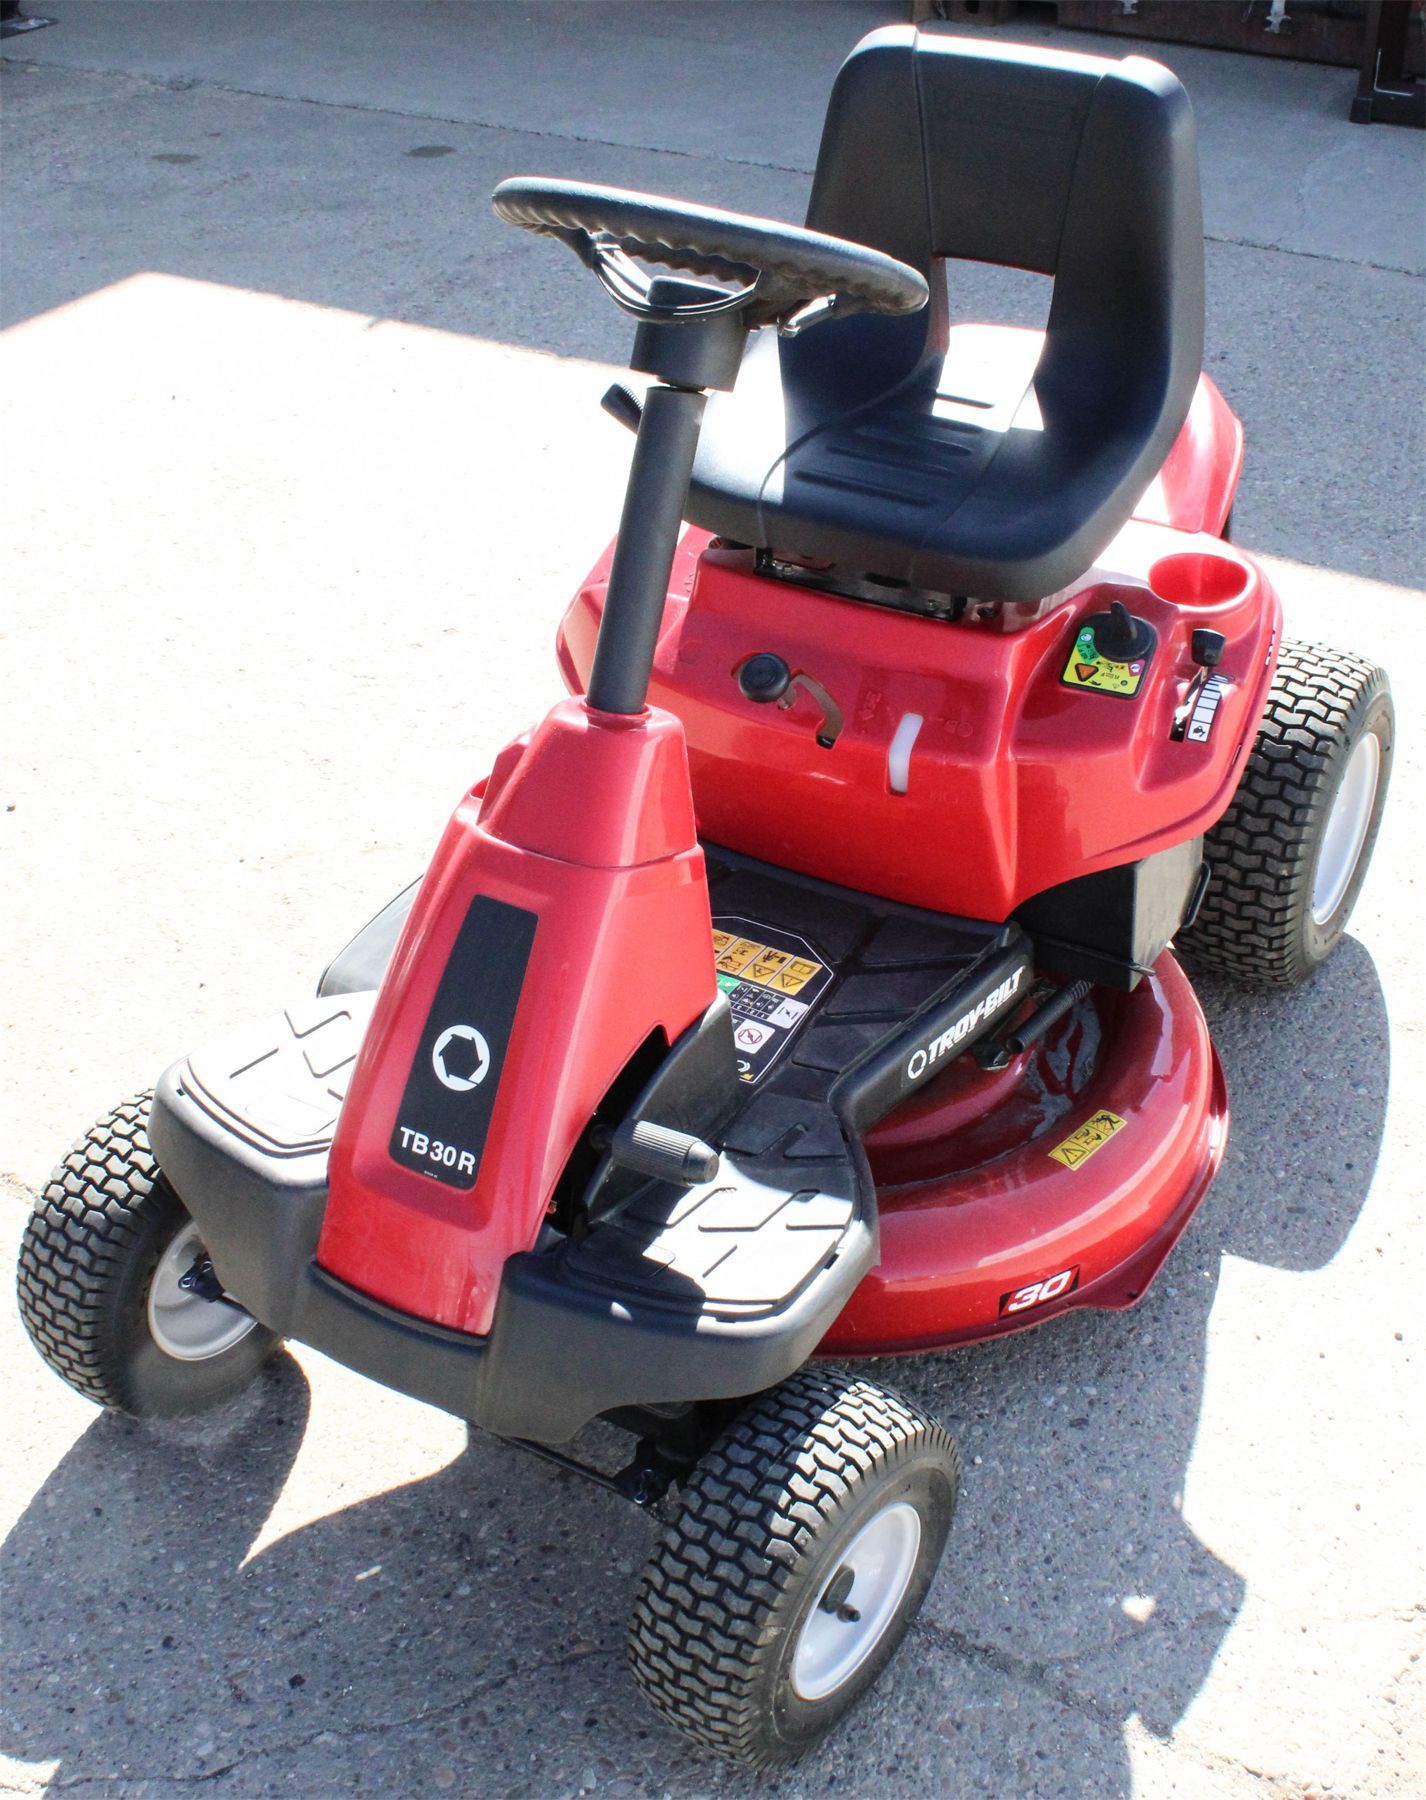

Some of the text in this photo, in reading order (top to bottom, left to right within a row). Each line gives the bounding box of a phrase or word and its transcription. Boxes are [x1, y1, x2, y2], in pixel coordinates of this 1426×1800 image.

[929, 965, 1026, 1064] TROY-BILT
[401, 1126, 476, 1175] TB30R
[1008, 1270, 1072, 1311] 30
